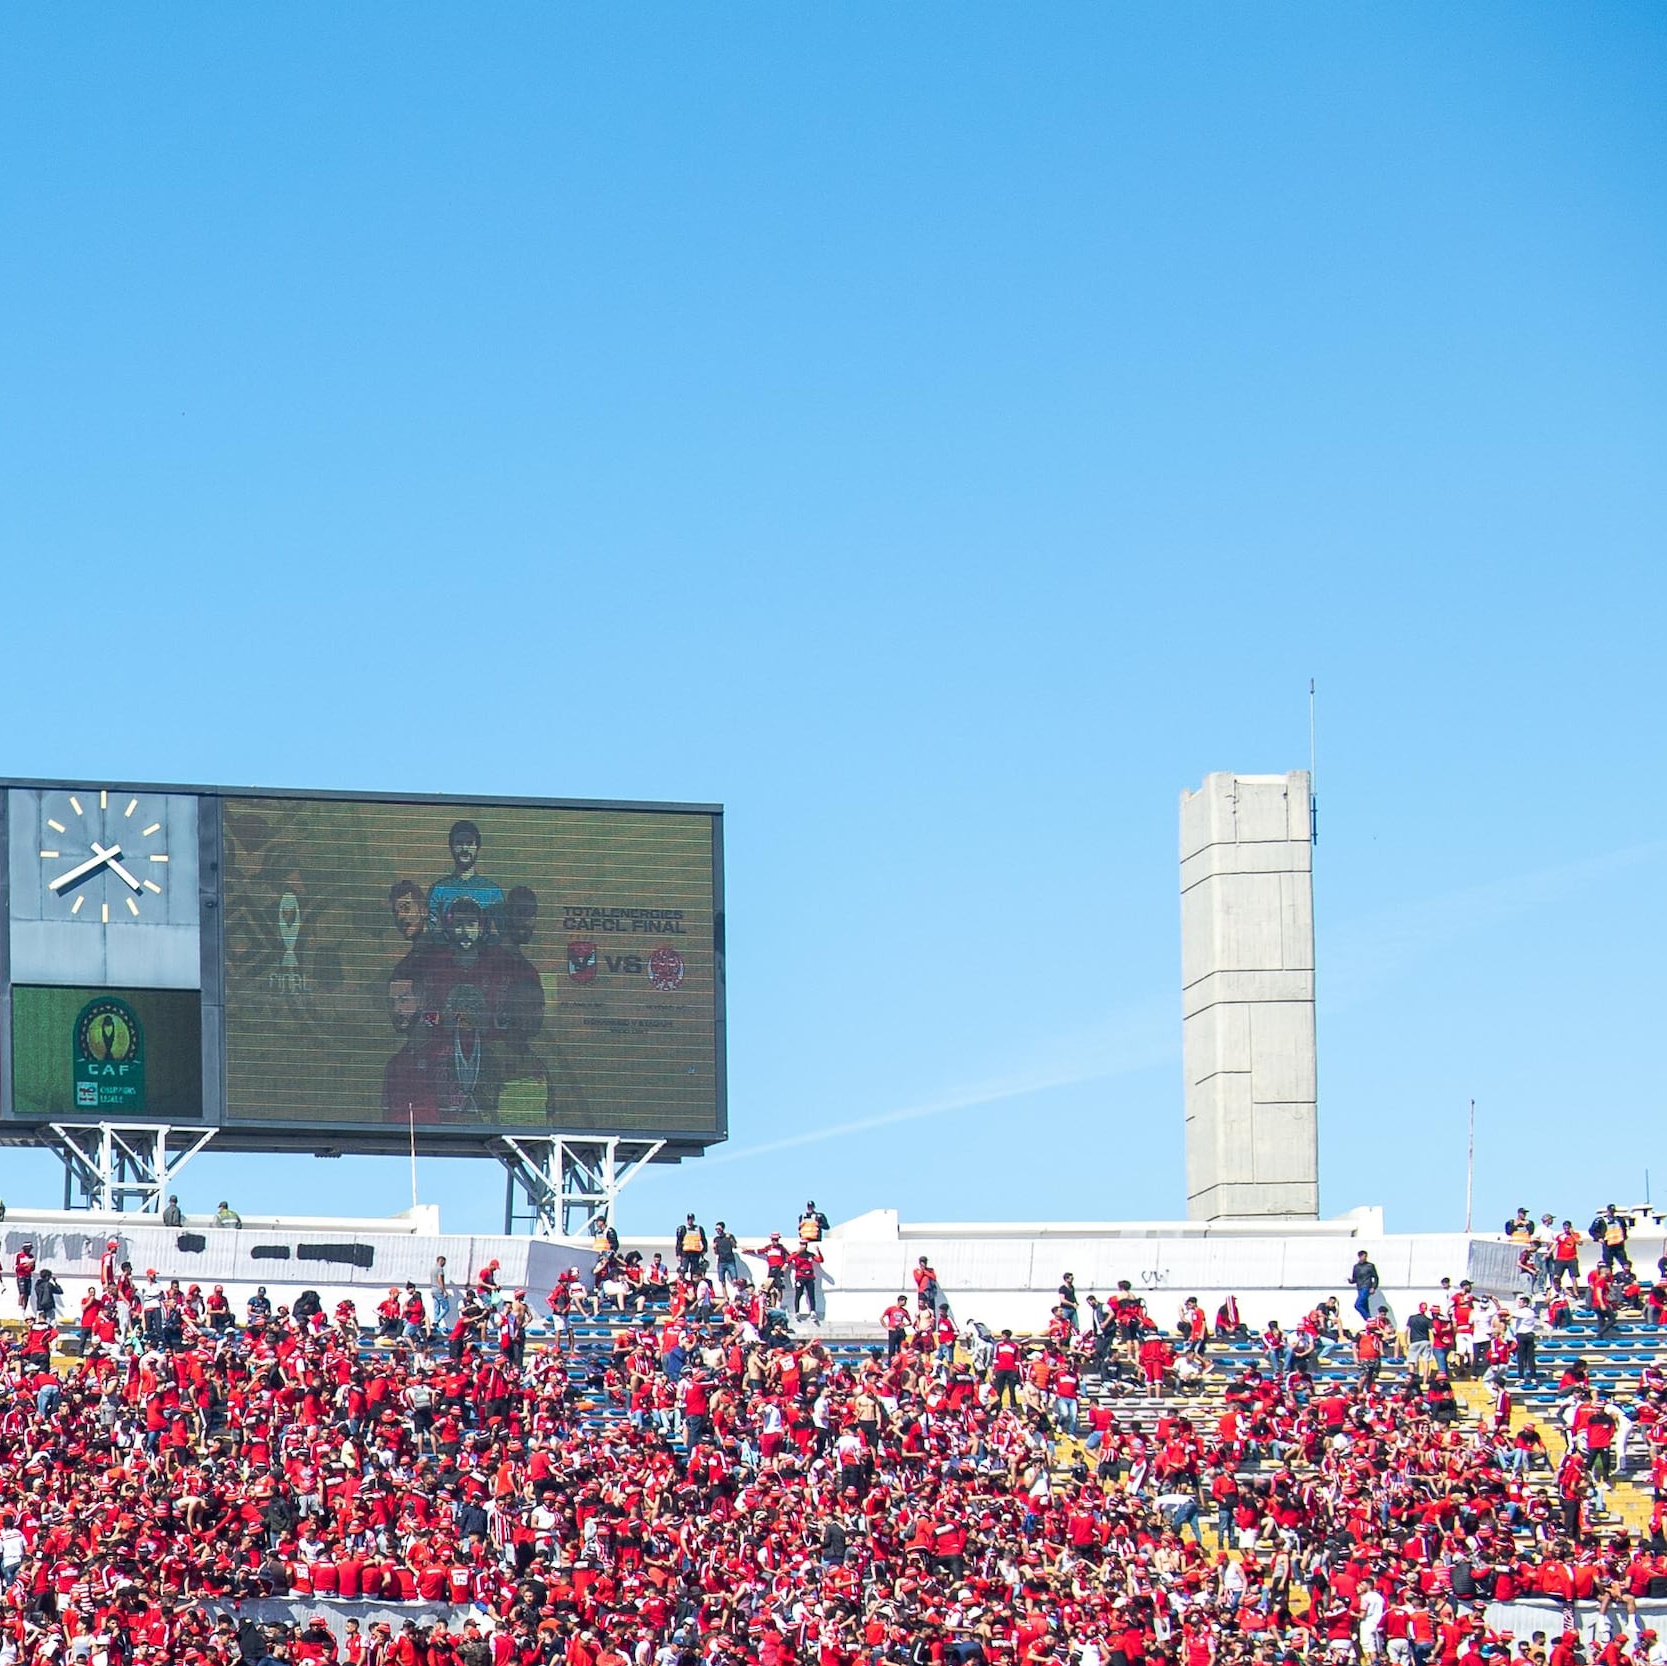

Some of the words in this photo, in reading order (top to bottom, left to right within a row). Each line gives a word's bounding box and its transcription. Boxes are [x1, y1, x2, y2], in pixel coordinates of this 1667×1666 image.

[563, 918, 627, 931] CAFCL
[632, 920, 687, 934] FINAL
[604, 955, 643, 973] VS
[88, 1064, 129, 1076] CAF
